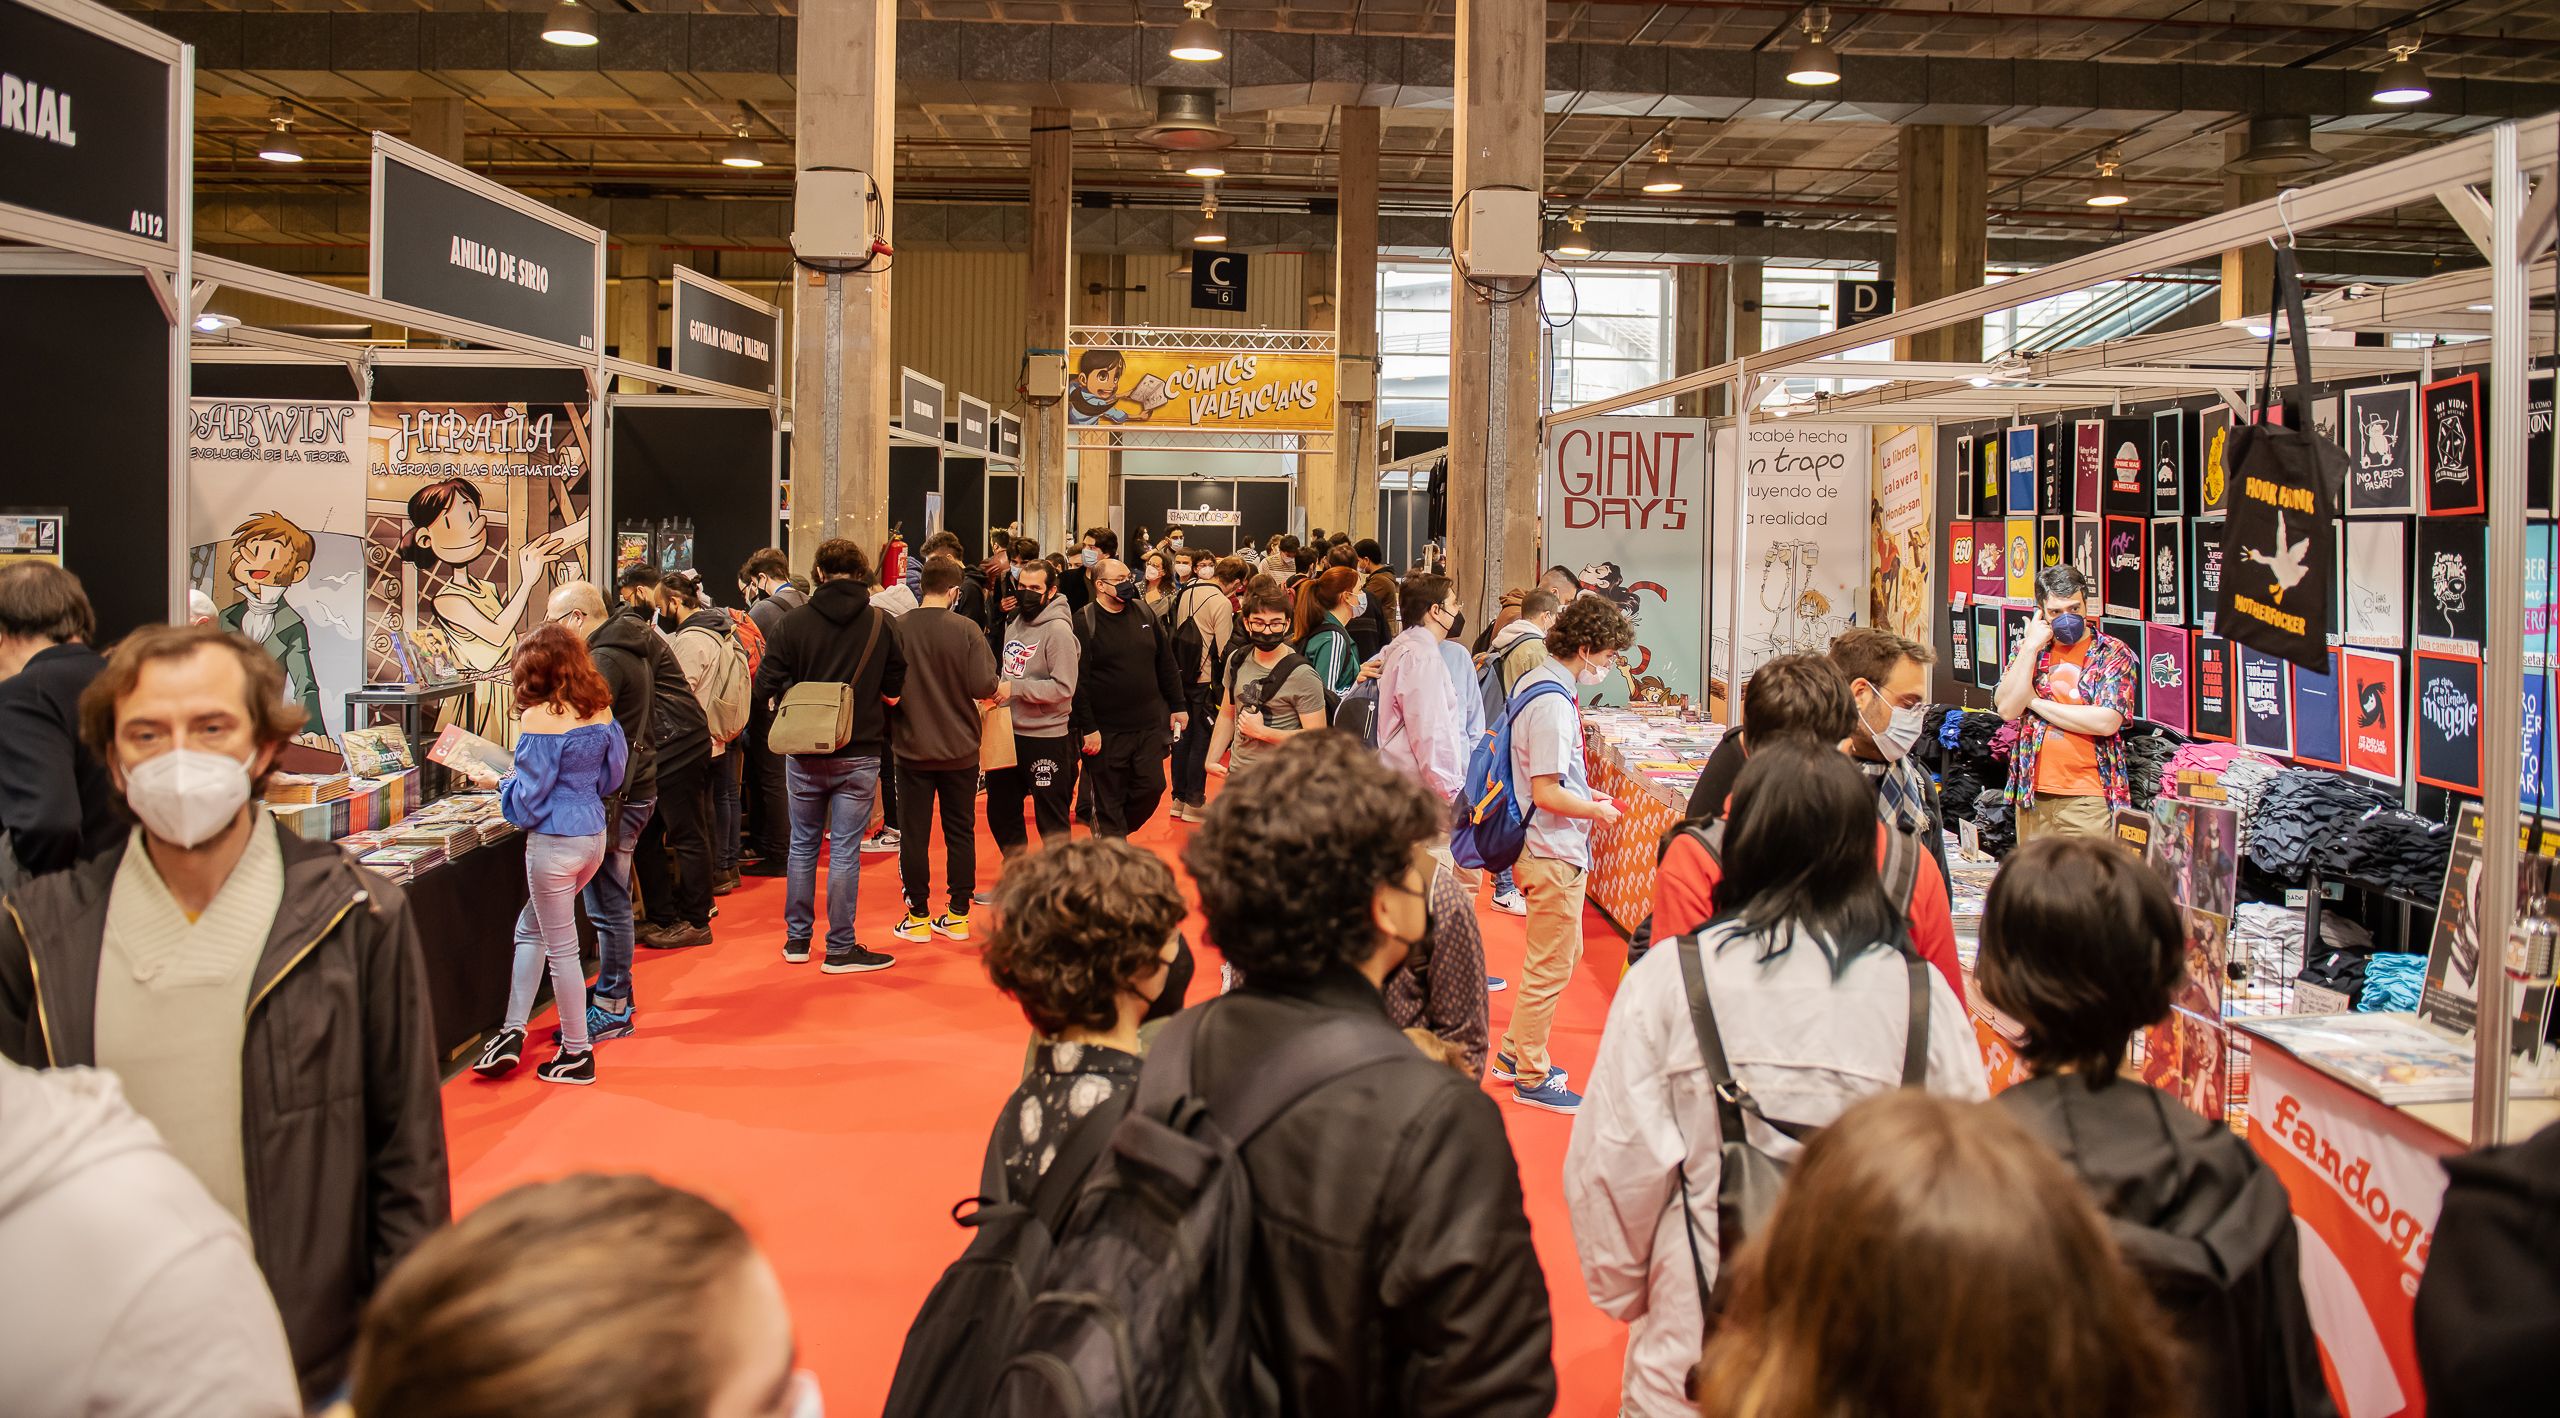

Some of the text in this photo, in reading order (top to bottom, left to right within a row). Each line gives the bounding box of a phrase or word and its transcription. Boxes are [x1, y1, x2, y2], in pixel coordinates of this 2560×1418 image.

[0, 72, 76, 148] RIAL
[130, 210, 163, 238] A112
[450, 235, 550, 294] ANILLO DE SIRIO
[1210, 257, 1231, 286] C
[1222, 291, 1230, 302] 6
[1854, 284, 1878, 313] D
[689, 318, 769, 363] GOTHAM COMICS VALENCIA
[1188, 378, 1318, 426] VALENCIANS
[2448, 399, 2465, 411] VIDA
[396, 407, 555, 462] HIPATIA
[1798, 429, 1847, 443] hecha
[263, 448, 282, 461] DE
[284, 449, 301, 461] LA
[304, 450, 350, 463] TEORÍA
[1558, 429, 1695, 498] GIANT
[1774, 447, 1845, 482] trapo
[1882, 443, 1918, 470] La librera
[372, 463, 581, 478] LA VERDAD EN LAS MATEMÁTICAS
[1883, 471, 1919, 496] calavera
[2373, 468, 2405, 482] PUEDES
[1816, 485, 1838, 498] de
[2245, 476, 2315, 515] HONK HONK
[2364, 478, 2393, 492] PASAR!
[1564, 497, 1688, 530] DAYS
[1760, 511, 1828, 526] realidad
[1884, 498, 1921, 521] Honda-san
[1953, 537, 1973, 564] EGO
[2431, 640, 2464, 653] camiseta
[2422, 696, 2478, 742] muggle
[1030, 758, 1060, 773] CALIFORNIA
